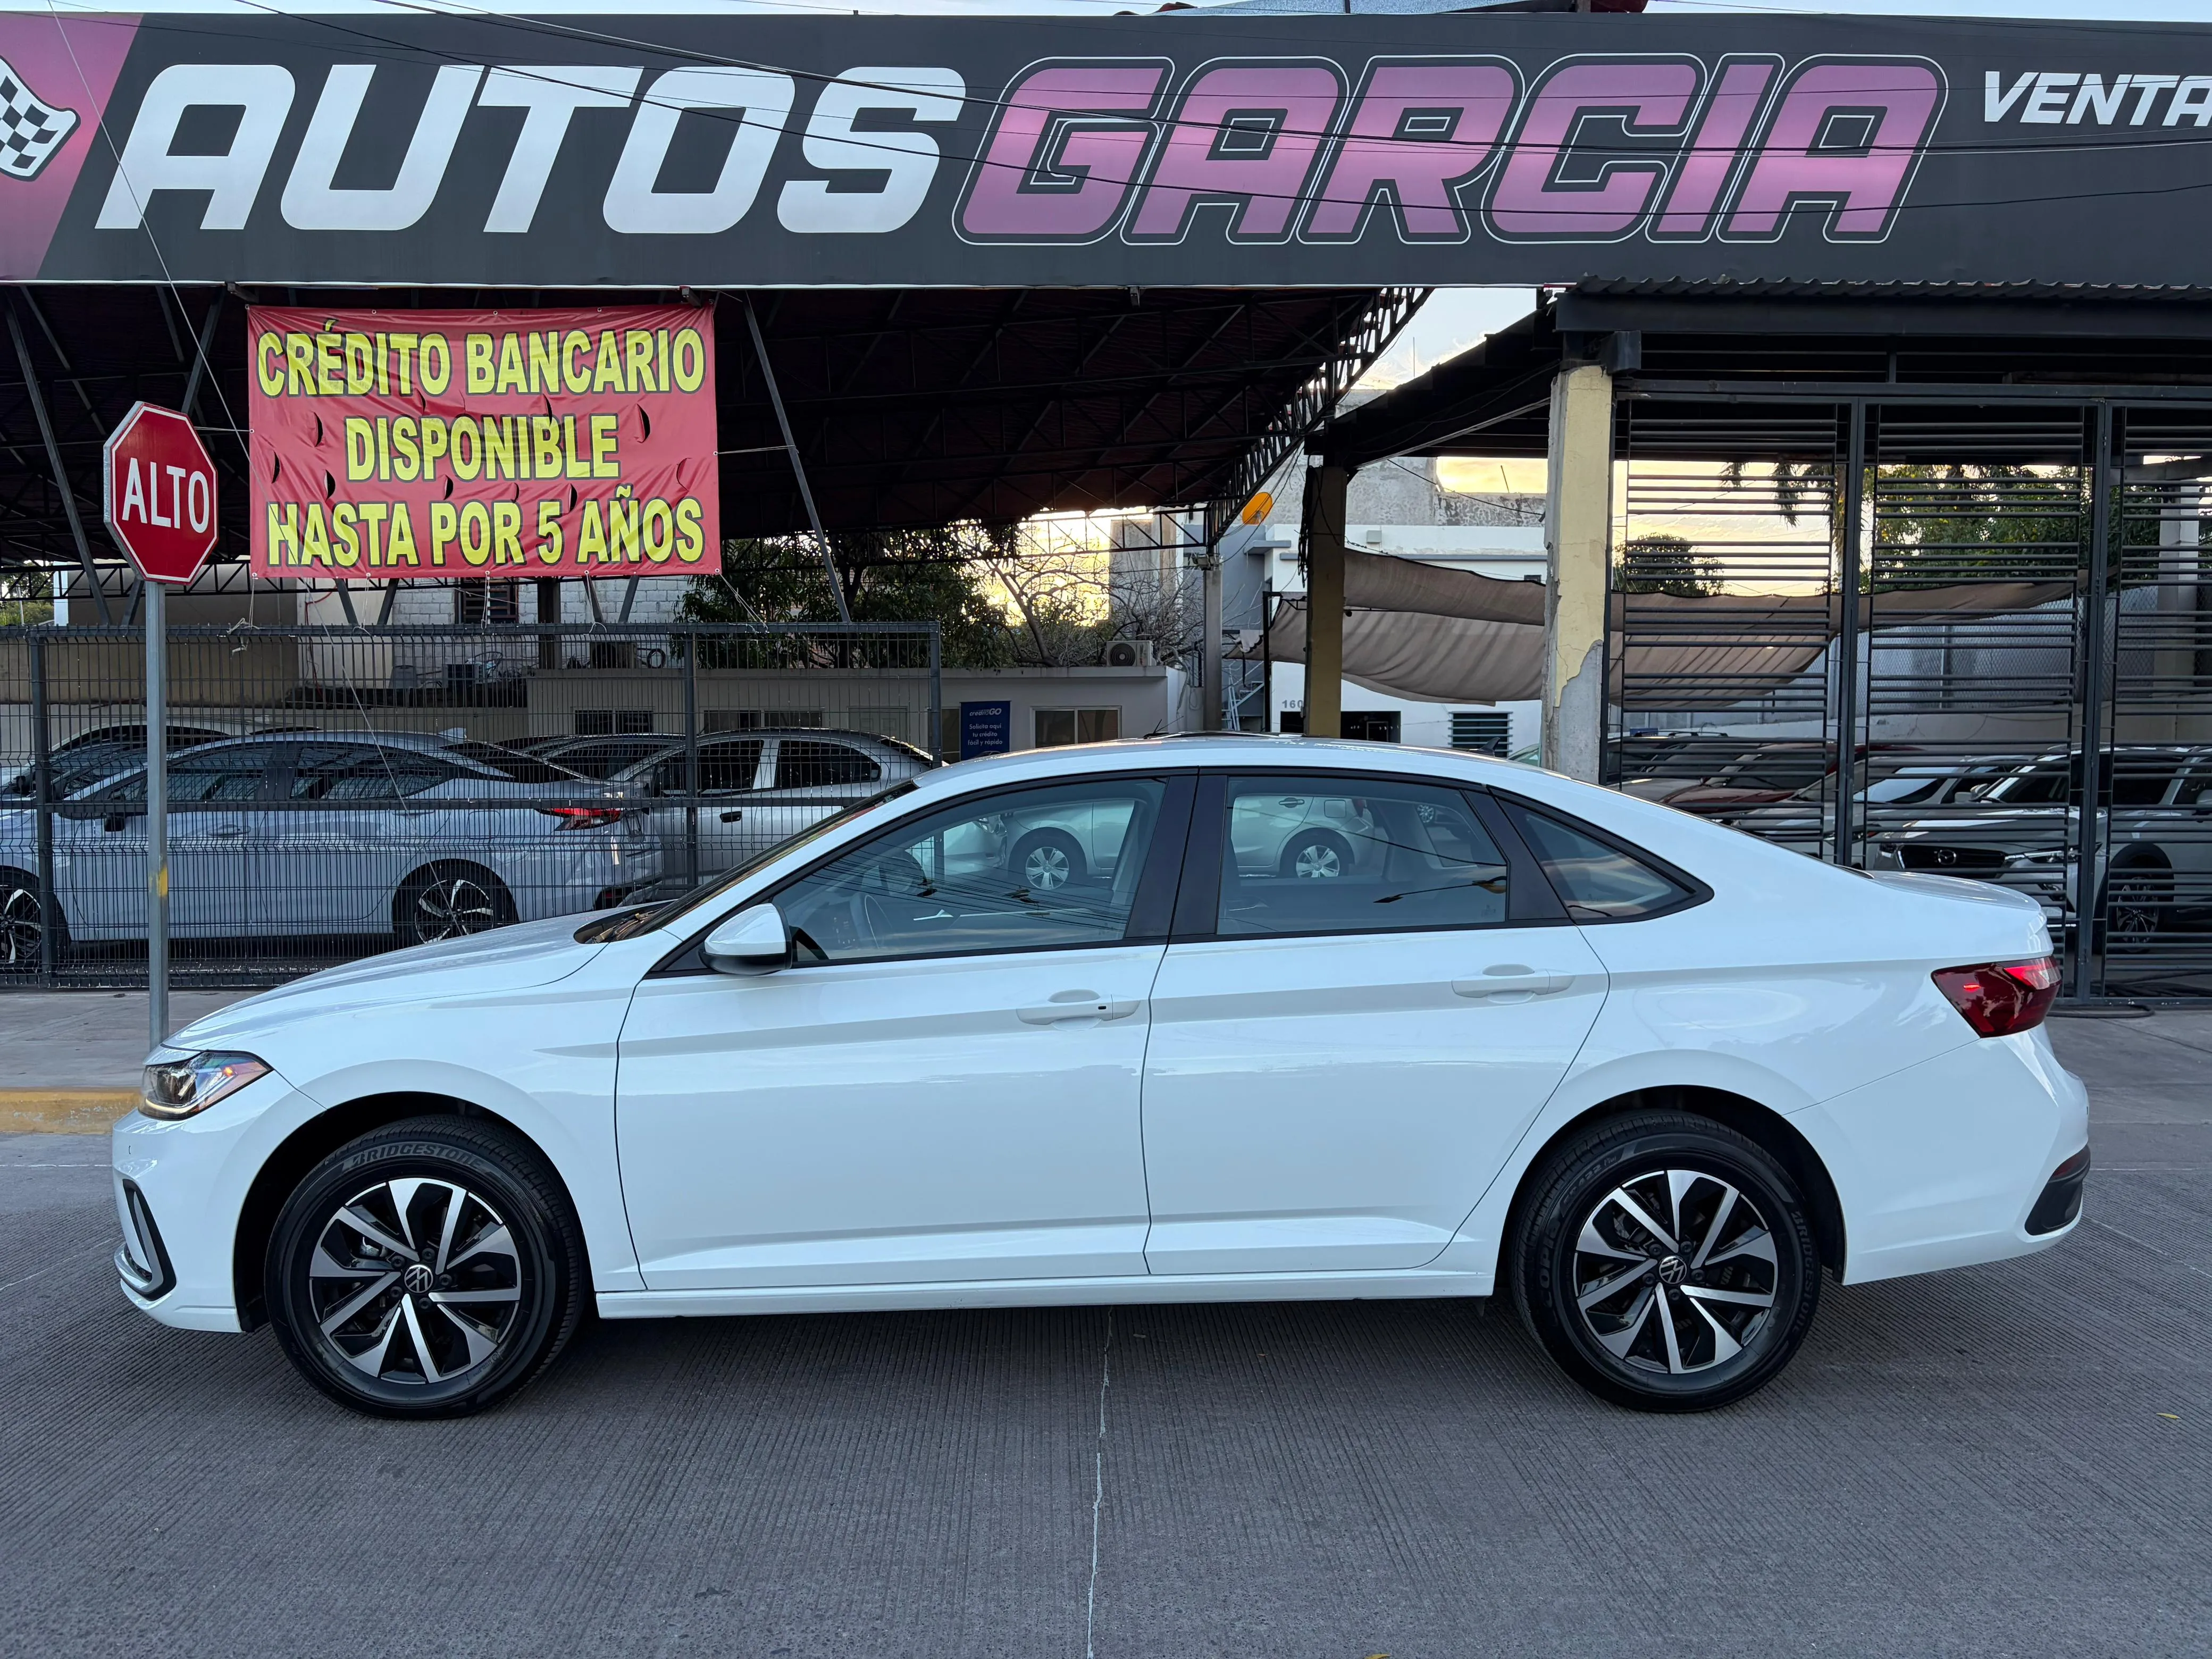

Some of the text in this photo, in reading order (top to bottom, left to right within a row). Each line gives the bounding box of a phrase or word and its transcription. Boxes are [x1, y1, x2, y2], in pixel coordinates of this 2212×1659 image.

[1984, 70, 2212, 127] VENTA
[95, 53, 1948, 245] AUTOS GARCIA
[256, 319, 706, 397] CRÉDITO BANCARIO
[345, 413, 621, 483] DISPONIBLE
[122, 457, 210, 533] ALTO
[266, 483, 706, 567] HASTA POR 5 AÑOS
[353, 1143, 484, 1169] BRIDGESTONE
